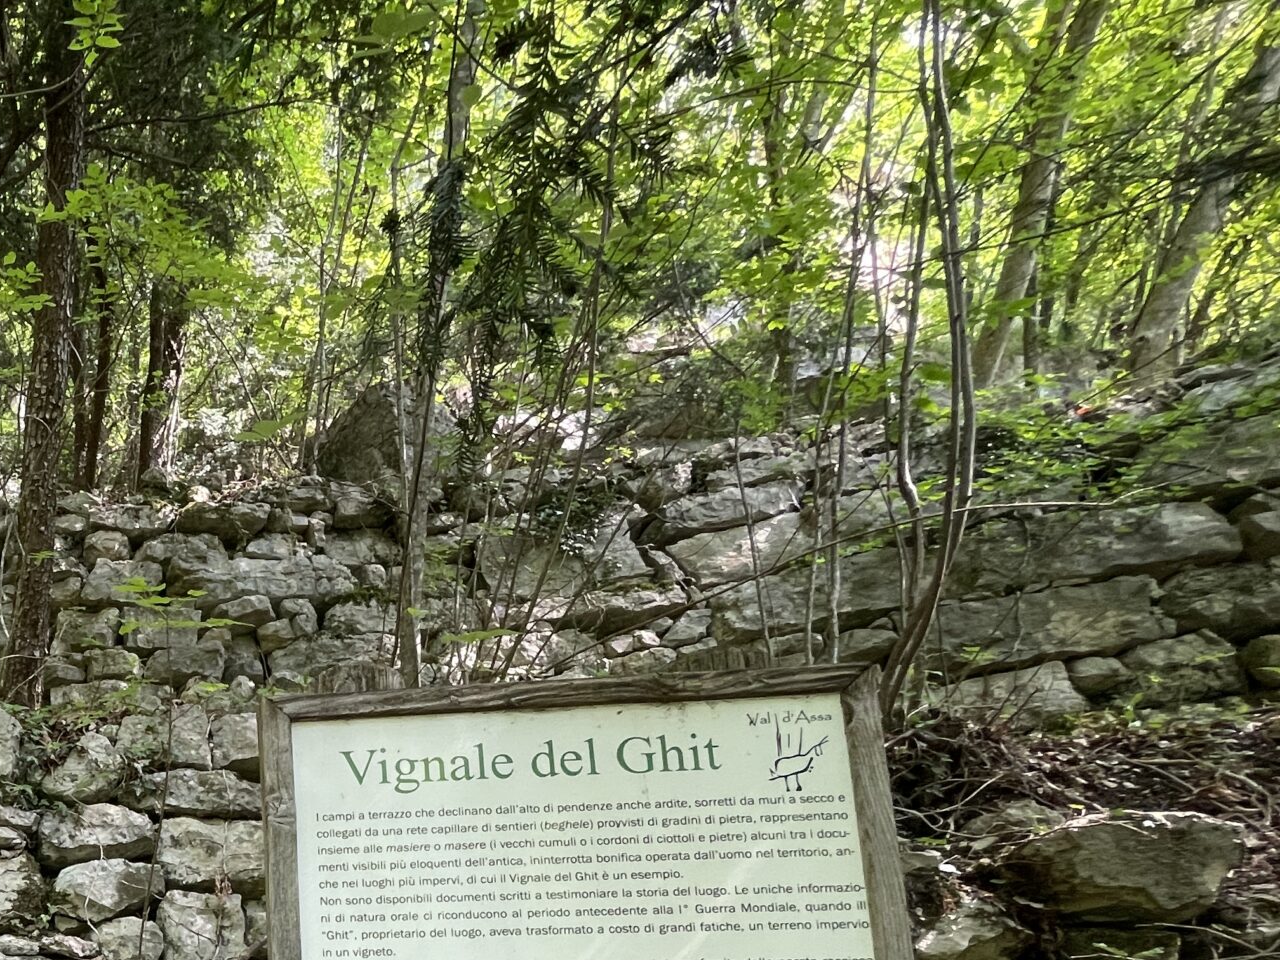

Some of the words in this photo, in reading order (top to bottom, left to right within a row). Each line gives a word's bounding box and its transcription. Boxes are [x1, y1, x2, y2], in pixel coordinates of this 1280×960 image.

[746, 711, 771, 727] Val
[783, 709, 833, 726] d'Assa
[339, 743, 515, 793] Vignale
[531, 738, 600, 778] del
[617, 732, 723, 775] Ghit
[315, 812, 319, 822] I
[321, 811, 355, 822] campi
[358, 812, 365, 820] a
[368, 810, 412, 820] terrazzo
[414, 808, 435, 818] che
[437, 806, 492, 817] declinano
[495, 804, 540, 814] dall'alto
[543, 803, 553, 813] di
[557, 802, 613, 814] pendenze
[615, 800, 651, 810] anche
[654, 798, 691, 809] ardite,
[694, 796, 736, 807] sorretti
[739, 796, 754, 806] da
[758, 794, 785, 805] muri
[788, 796, 796, 804] a
[798, 794, 834, 803] secco
[837, 794, 845, 802] e
[316, 827, 361, 839] collegati
[364, 826, 378, 837] da
[381, 827, 403, 836] una
[406, 825, 428, 835] rete
[430, 823, 478, 835] capillare
[481, 823, 492, 832] di
[494, 821, 536, 832] sentieri
[539, 819, 593, 832] (beghele)
[596, 817, 644, 830] provvisti
[647, 816, 658, 826] di
[661, 815, 701, 828] gradini
[704, 814, 715, 824] di
[718, 814, 756, 826] pietra,
[759, 812, 848, 824] rappresentano
[317, 845, 360, 855] insieme
[362, 843, 383, 853] alle
[385, 842, 431, 852] masiere
[433, 843, 441, 851] o
[443, 841, 486, 850] masere
[499, 838, 535, 848] vecchi
[538, 836, 576, 847] cumuli
[579, 838, 587, 846] o
[590, 836, 593, 845] i
[596, 834, 639, 846] cordoni
[642, 834, 653, 844] di
[656, 833, 695, 843] ciottoli
[698, 834, 705, 842] e
[708, 831, 747, 843] pietre)
[750, 829, 786, 841] alcuni
[789, 830, 806, 839] tra
[809, 828, 813, 838] i
[816, 828, 851, 839] docu-
[318, 862, 349, 872] menti
[351, 860, 386, 870] visibili
[389, 859, 406, 871] più
[409, 857, 461, 870] eloquenti
[464, 856, 526, 867] dell'antica,
[529, 854, 592, 864] ininterrotta
[595, 852, 642, 863] bonifica
[644, 851, 690, 863] operata
[693, 850, 752, 860] dall'uomo
[755, 848, 774, 858] nel
[776, 847, 832, 858] territorio,
[835, 847, 855, 856] an-
[318, 879, 338, 889] che
[341, 879, 358, 888] nei
[361, 877, 394, 889] luoghi
[398, 875, 415, 888] più
[418, 875, 463, 887] impervi,
[466, 874, 477, 884] di
[480, 874, 496, 884] cui
[500, 873, 506, 883] il
[508, 872, 551, 885] Vignale
[554, 871, 572, 882] del
[574, 871, 599, 881] Ghit
[601, 870, 609, 880] è
[612, 872, 627, 880] un
[630, 869, 684, 881] esempio.
[319, 896, 342, 906] Non
[344, 897, 372, 905] sono
[375, 892, 432, 906] disponibili
[435, 891, 496, 903] documenti
[499, 890, 531, 901] scritti
[534, 892, 542, 900] a
[545, 888, 618, 900] testimoniare
[621, 888, 632, 897] la
[635, 887, 669, 897] storia
[672, 886, 691, 896] del
[694, 885, 730, 898] luogo.
[734, 885, 749, 895] Le
[752, 883, 793, 894] uniche
[796, 882, 864, 893] informazio-
[320, 913, 330, 923] ni
[334, 913, 345, 923] di
[349, 913, 386, 922] natura
[390, 911, 419, 921] orale
[423, 910, 432, 920] ci
[437, 909, 507, 920] riconducono
[511, 908, 522, 918] al
[527, 907, 571, 920] periodo
[575, 906, 648, 917] antecedente
[652, 904, 674, 915] alla
[694, 903, 736, 914] Guerra
[740, 901, 800, 912] Mondiale,
[804, 900, 852, 913] quando
